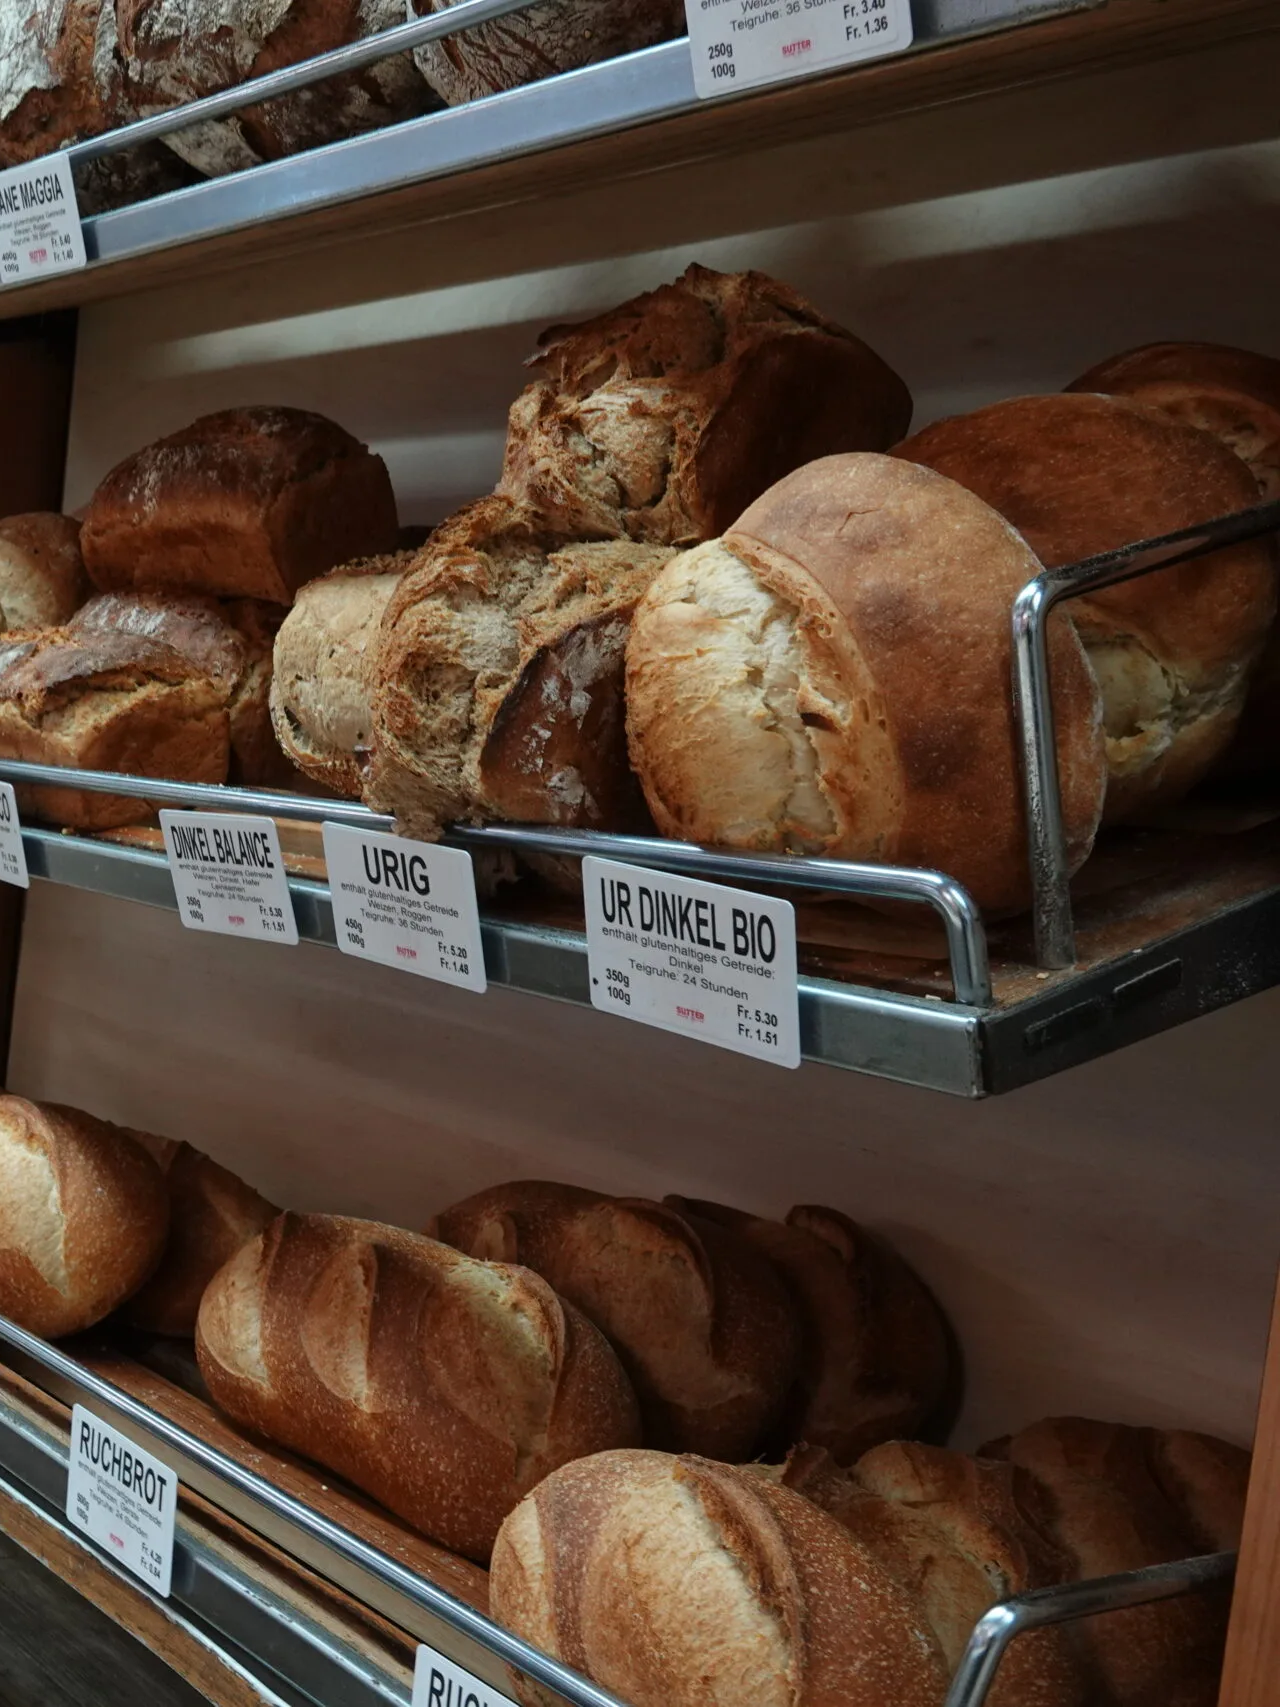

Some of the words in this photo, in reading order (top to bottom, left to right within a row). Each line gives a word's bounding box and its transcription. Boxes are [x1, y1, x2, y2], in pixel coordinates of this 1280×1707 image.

[730, 10, 781, 31] Teigruhe:
[786, 2, 801, 16] 36
[843, 4, 859, 20] Fr.
[846, 25, 862, 41] Fr.
[864, 15, 888, 35] 1.36
[708, 42, 733, 60] 250g
[782, 40, 811, 54] SUTTER
[711, 61, 736, 80] 100g
[19, 173, 64, 209] MAGGIA
[170, 825, 216, 863] DINKEL
[213, 829, 274, 869] BALANCE
[362, 845, 430, 896] URIG
[186, 896, 201, 909] 350g
[341, 883, 366, 895] enthält
[368, 889, 422, 908] glutenhaltiges
[189, 910, 204, 922] 100g
[259, 905, 268, 916] Fr.
[269, 907, 282, 918] 5.30
[401, 907, 432, 923] Roggen
[601, 877, 634, 928] UR
[638, 886, 726, 951] DINKEL
[732, 908, 776, 963] BIO
[262, 919, 271, 930] Fr.
[272, 922, 285, 932] 1.51
[345, 918, 363, 933] 450g
[398, 918, 408, 928] 36
[410, 921, 444, 937] Stunden
[347, 932, 365, 948] 100g
[438, 941, 449, 954] Fr.
[450, 945, 467, 959] 5.20
[602, 927, 638, 943] enthält
[641, 937, 717, 964] glutenhaltiges
[721, 956, 774, 979] Getreide:
[440, 957, 451, 970] Fr.
[453, 961, 469, 975] 1.48
[669, 955, 703, 974] Dinkel
[606, 968, 630, 988] 350g
[629, 958, 678, 980] Teigruhe:
[683, 973, 697, 986] 24
[700, 978, 748, 1000] Stunden
[607, 986, 631, 1006] 100g
[676, 1006, 704, 1020] SUTTER
[737, 1004, 752, 1020] Fr.
[755, 1010, 778, 1027] 5.30
[738, 1023, 752, 1038] Fr.
[756, 1029, 777, 1046] 1.51
[80, 1421, 167, 1512] RUCHBROT
[140, 1540, 149, 1556] Fr.
